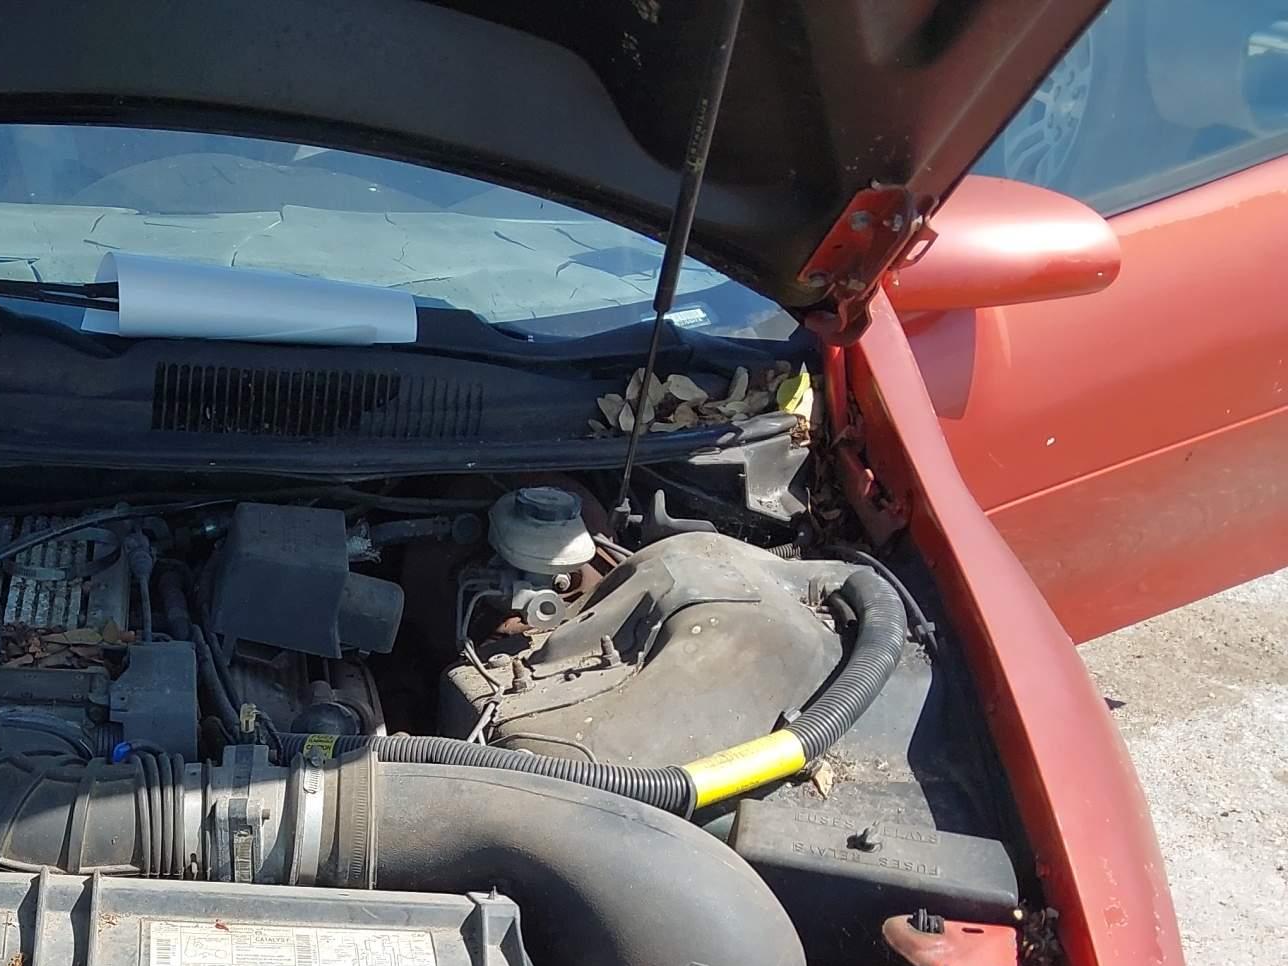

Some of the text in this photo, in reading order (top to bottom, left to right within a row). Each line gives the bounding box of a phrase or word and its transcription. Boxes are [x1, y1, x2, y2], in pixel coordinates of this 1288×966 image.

[794, 811, 939, 844] FUSES ELAYS
[878, 857, 941, 877] FUSES
